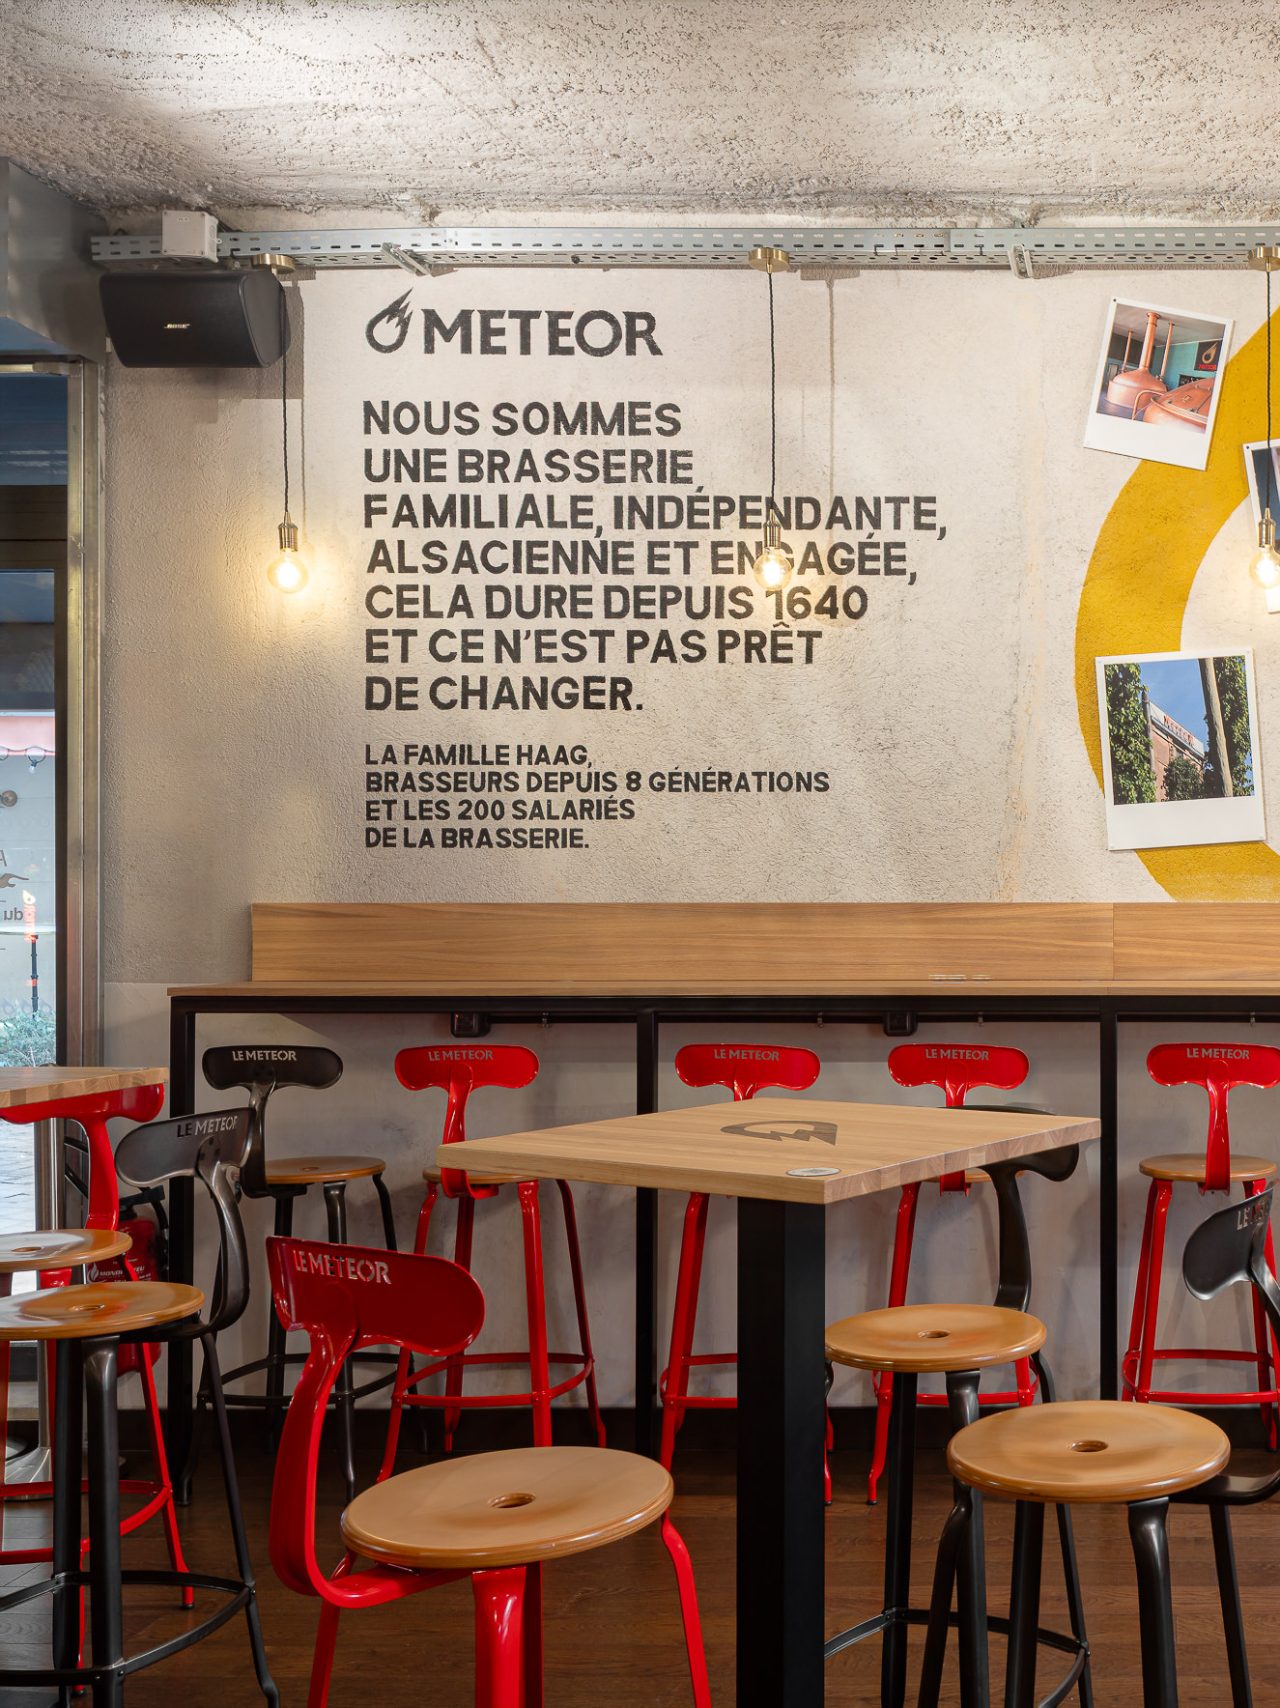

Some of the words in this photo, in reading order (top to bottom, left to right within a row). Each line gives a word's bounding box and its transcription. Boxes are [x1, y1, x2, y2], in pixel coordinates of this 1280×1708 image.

[422, 308, 663, 357] METEOR
[363, 401, 480, 436] NOUS
[492, 401, 682, 437] SOMMES
[364, 448, 447, 483] UNE
[458, 448, 694, 485] BRASSERIE
[364, 494, 604, 540] FAMILIALE,
[613, 484, 947, 541] INDÉPENDANTE,
[367, 539, 635, 575] ALSACIENNE
[647, 540, 699, 575] ET
[365, 584, 474, 619] CELA
[484, 584, 593, 620] DURE
[603, 584, 754, 620] DEPUIS
[764, 585, 869, 620] 1640
[365, 628, 418, 664] ET
[428, 628, 484, 664] CE
[626, 629, 707, 664] PAS
[717, 621, 823, 665] PRÊT
[364, 675, 419, 712] DE
[428, 675, 643, 712] CHANGER.
[365, 744, 398, 766] LA
[404, 744, 510, 766] FAMILLE
[516, 744, 593, 769] HAAG,
[365, 771, 520, 793] BRASSEURS
[526, 771, 618, 793] DEPUIS
[625, 770, 642, 793] 8
[648, 765, 830, 793] GÉNÉRATIONS
[365, 799, 398, 821] ET
[403, 799, 451, 821] LES
[457, 799, 505, 821] 200
[511, 795, 635, 821] SALARIÉS
[364, 827, 397, 849] DE
[403, 827, 435, 849] LA
[441, 827, 589, 849] BRASSERIE.
[232, 1051, 245, 1061] LE
[245, 1051, 297, 1061] METEOR
[428, 1051, 440, 1062] LE
[442, 1050, 494, 1061] METEOR
[714, 1049, 727, 1060] LE
[728, 1049, 780, 1061] METEOR
[925, 1048, 938, 1059] LE
[940, 1049, 989, 1061] METEOR
[1186, 1048, 1199, 1058] LE
[1201, 1048, 1250, 1060] METEOR
[177, 1122, 193, 1138] LE
[293, 1250, 308, 1273] LE
[308, 1252, 392, 1285] METEOR
